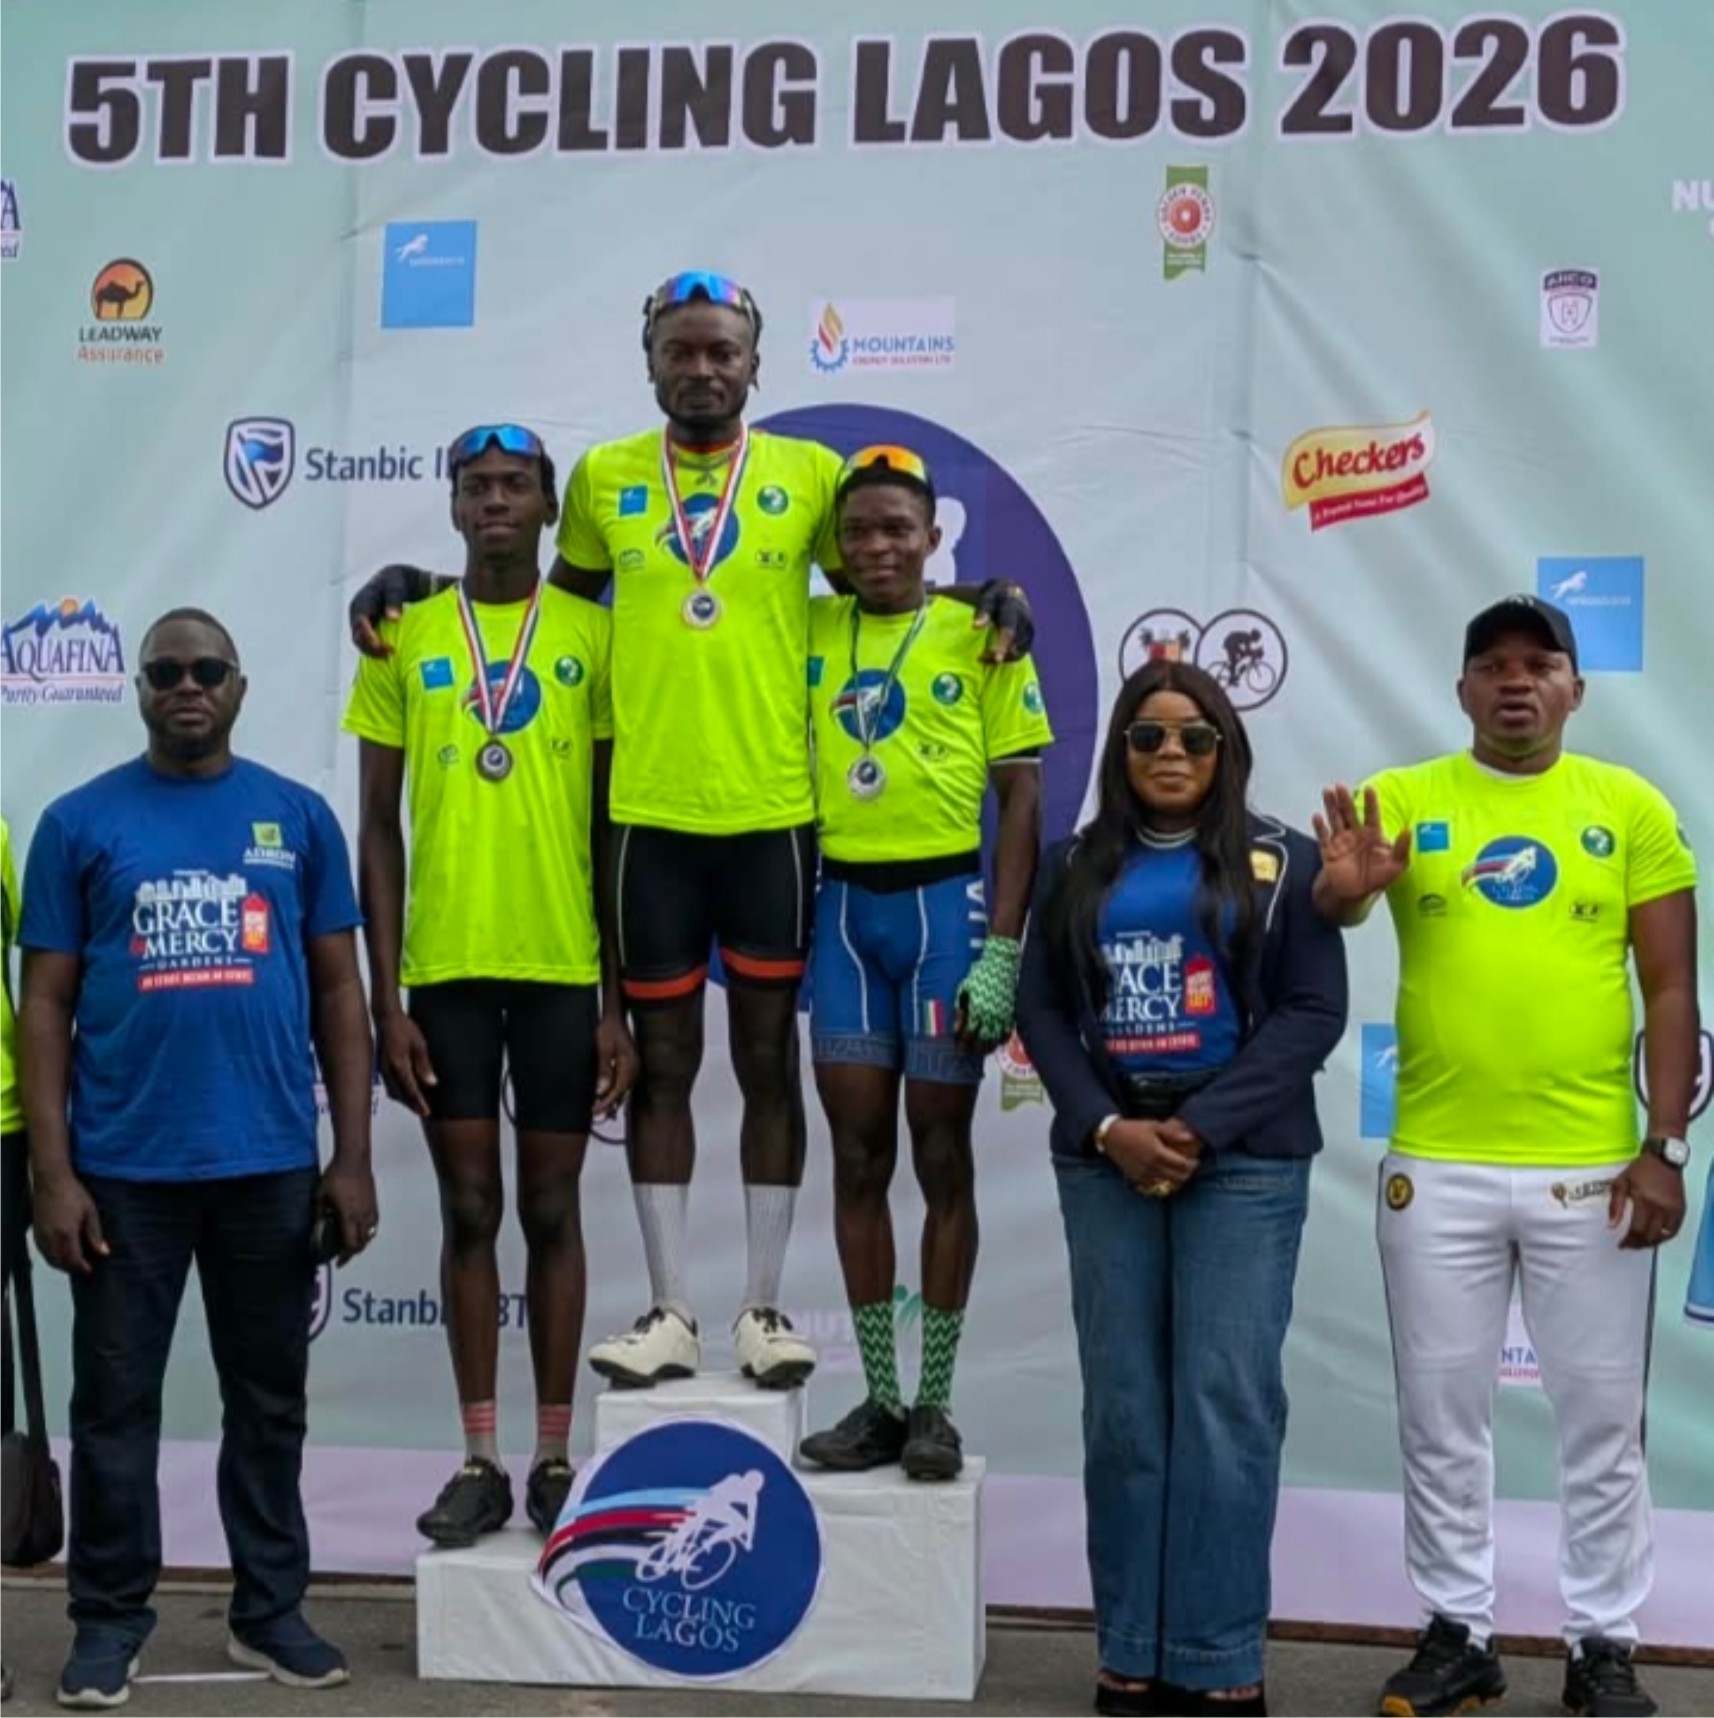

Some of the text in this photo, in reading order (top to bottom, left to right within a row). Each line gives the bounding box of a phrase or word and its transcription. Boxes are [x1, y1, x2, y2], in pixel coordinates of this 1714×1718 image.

[69, 14, 1621, 163] 5TH CYCLING LAGOS 2026
[78, 326, 163, 342] LEADWAY
[853, 334, 956, 353] MOUNTAINS
[77, 347, 165, 363] Assurance
[305, 446, 423, 481] Stanbic
[1292, 431, 1425, 489] Checkers
[1, 623, 125, 683] AQUAFINA
[132, 897, 240, 936] GRACE
[142, 929, 239, 960] MERCY
[1117, 961, 1182, 996] ACE
[342, 1287, 447, 1327] Stanb
[621, 1585, 757, 1631] CYCLING
[633, 1612, 740, 1653] LAGOS
